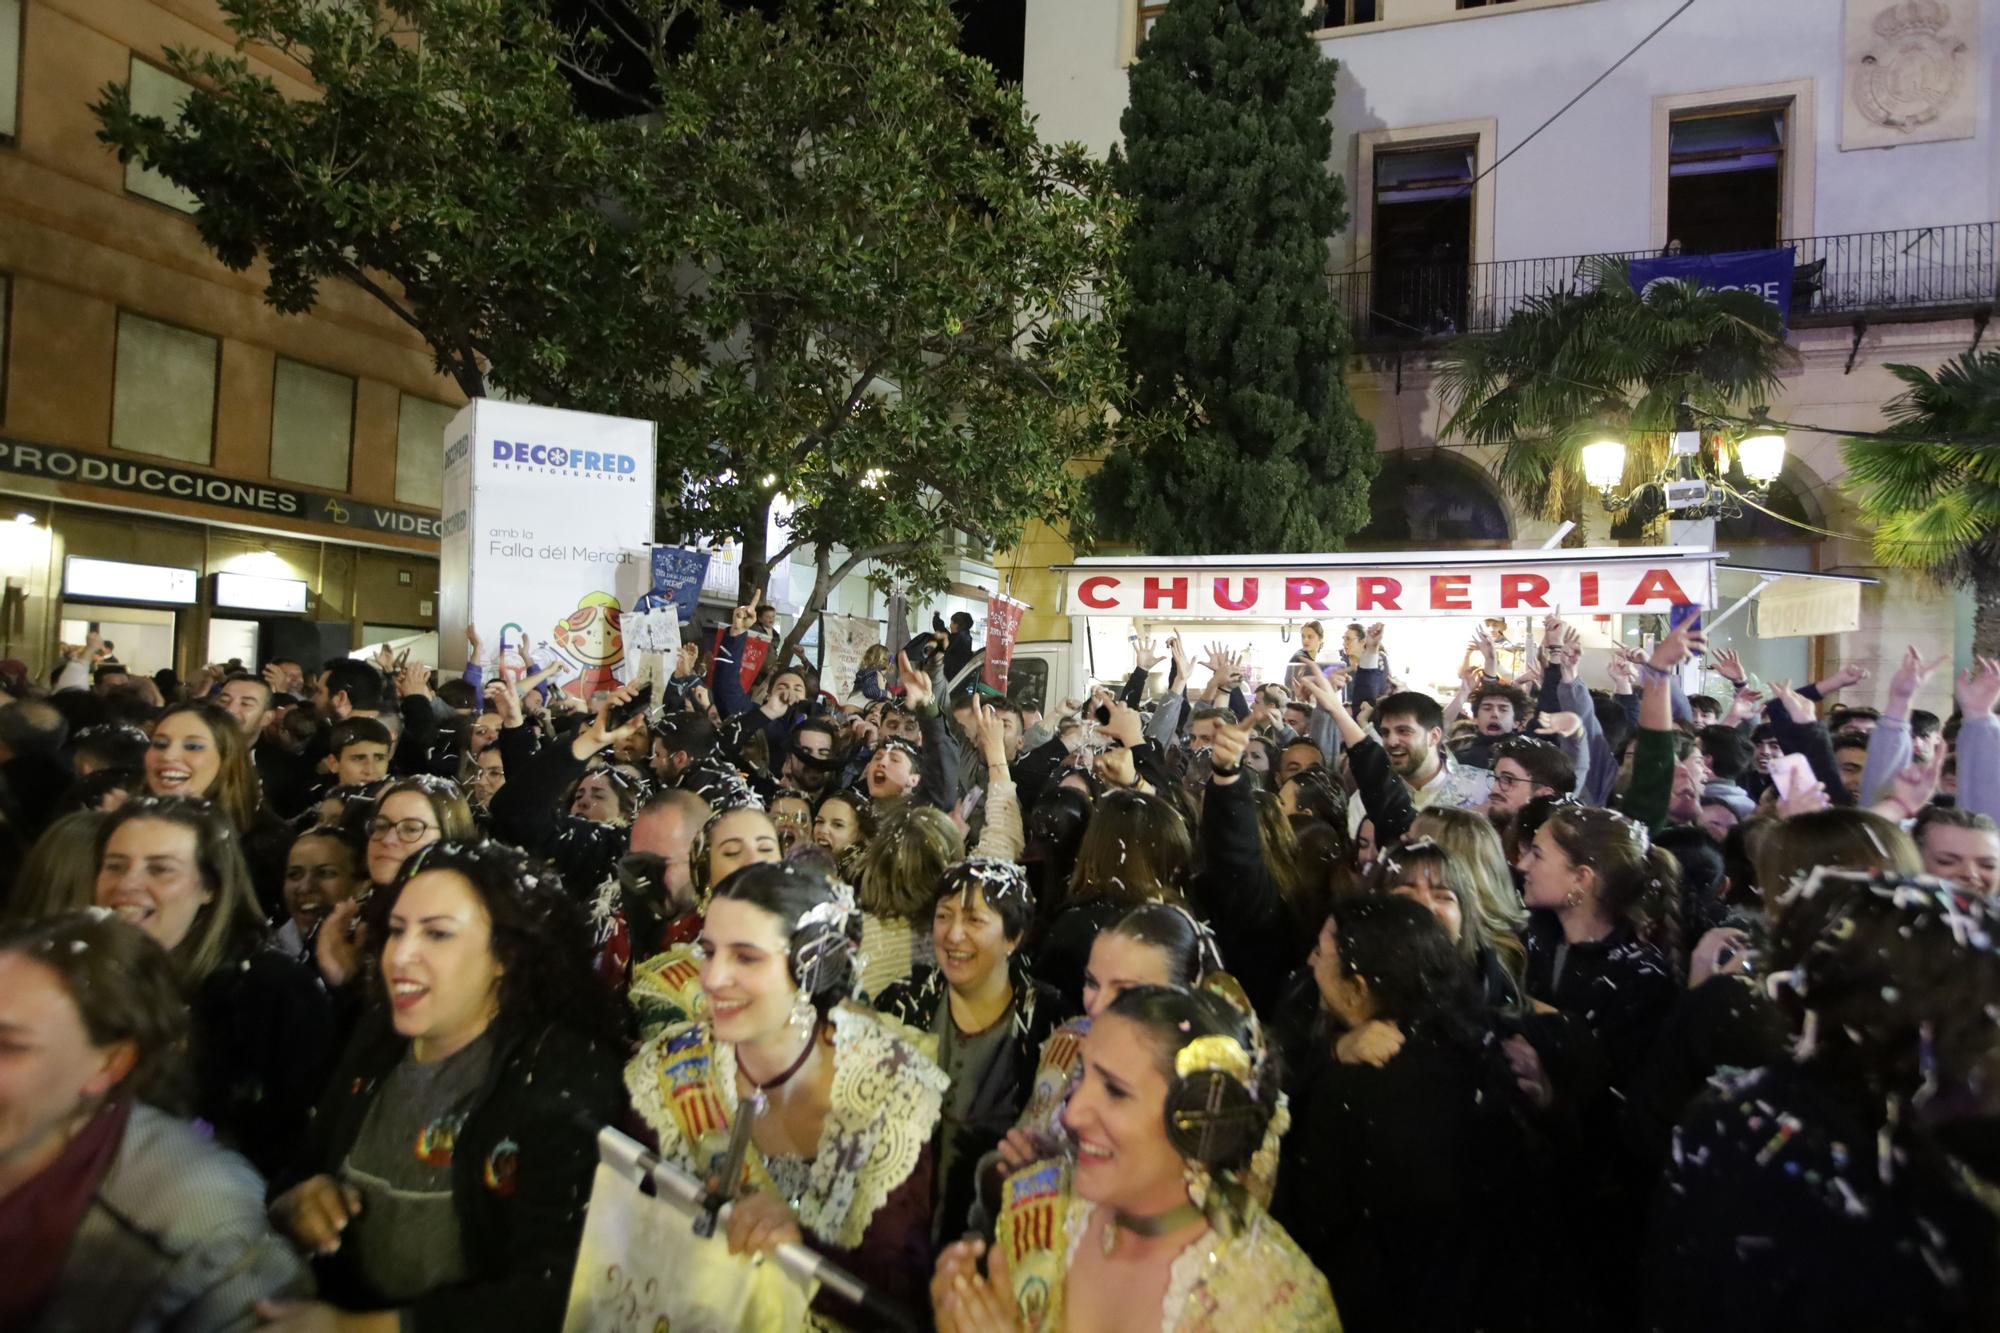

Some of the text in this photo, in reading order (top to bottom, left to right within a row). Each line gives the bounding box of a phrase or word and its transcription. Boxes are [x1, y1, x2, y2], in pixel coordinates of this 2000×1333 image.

[493, 439, 636, 475] DECOFRED
[493, 462, 636, 483] REFRIGERACIÓN
[489, 528, 534, 539] amb la
[490, 540, 533, 558] Falla
[572, 545, 633, 565] Mercat
[1077, 569, 1693, 611] CHURRERIA
